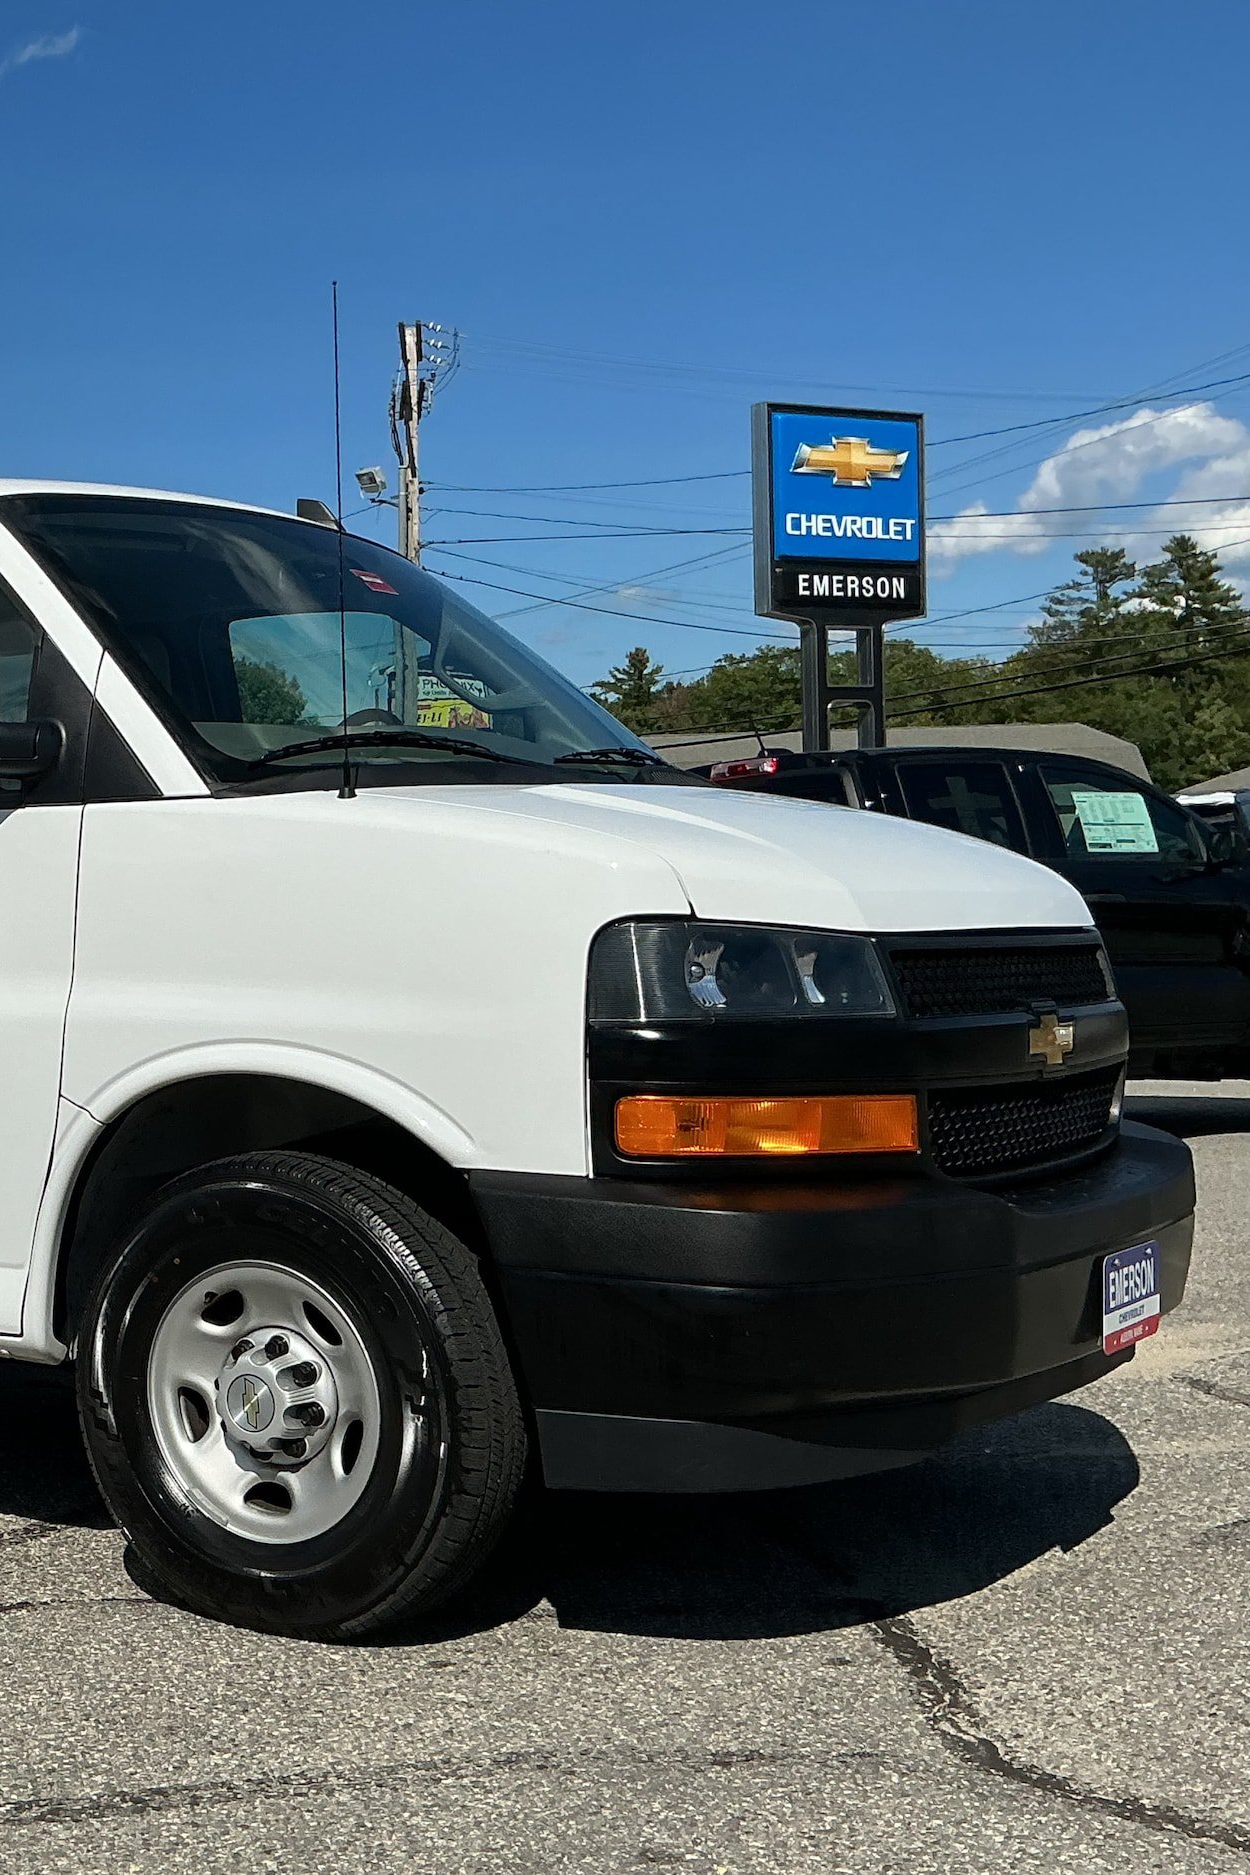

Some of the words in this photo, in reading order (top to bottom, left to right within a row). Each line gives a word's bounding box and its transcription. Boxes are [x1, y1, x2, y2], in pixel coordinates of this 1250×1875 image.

[786, 513, 915, 540] CHEVROLET
[798, 574, 905, 599] EMERSON
[1109, 1257, 1154, 1309] EMERSON
